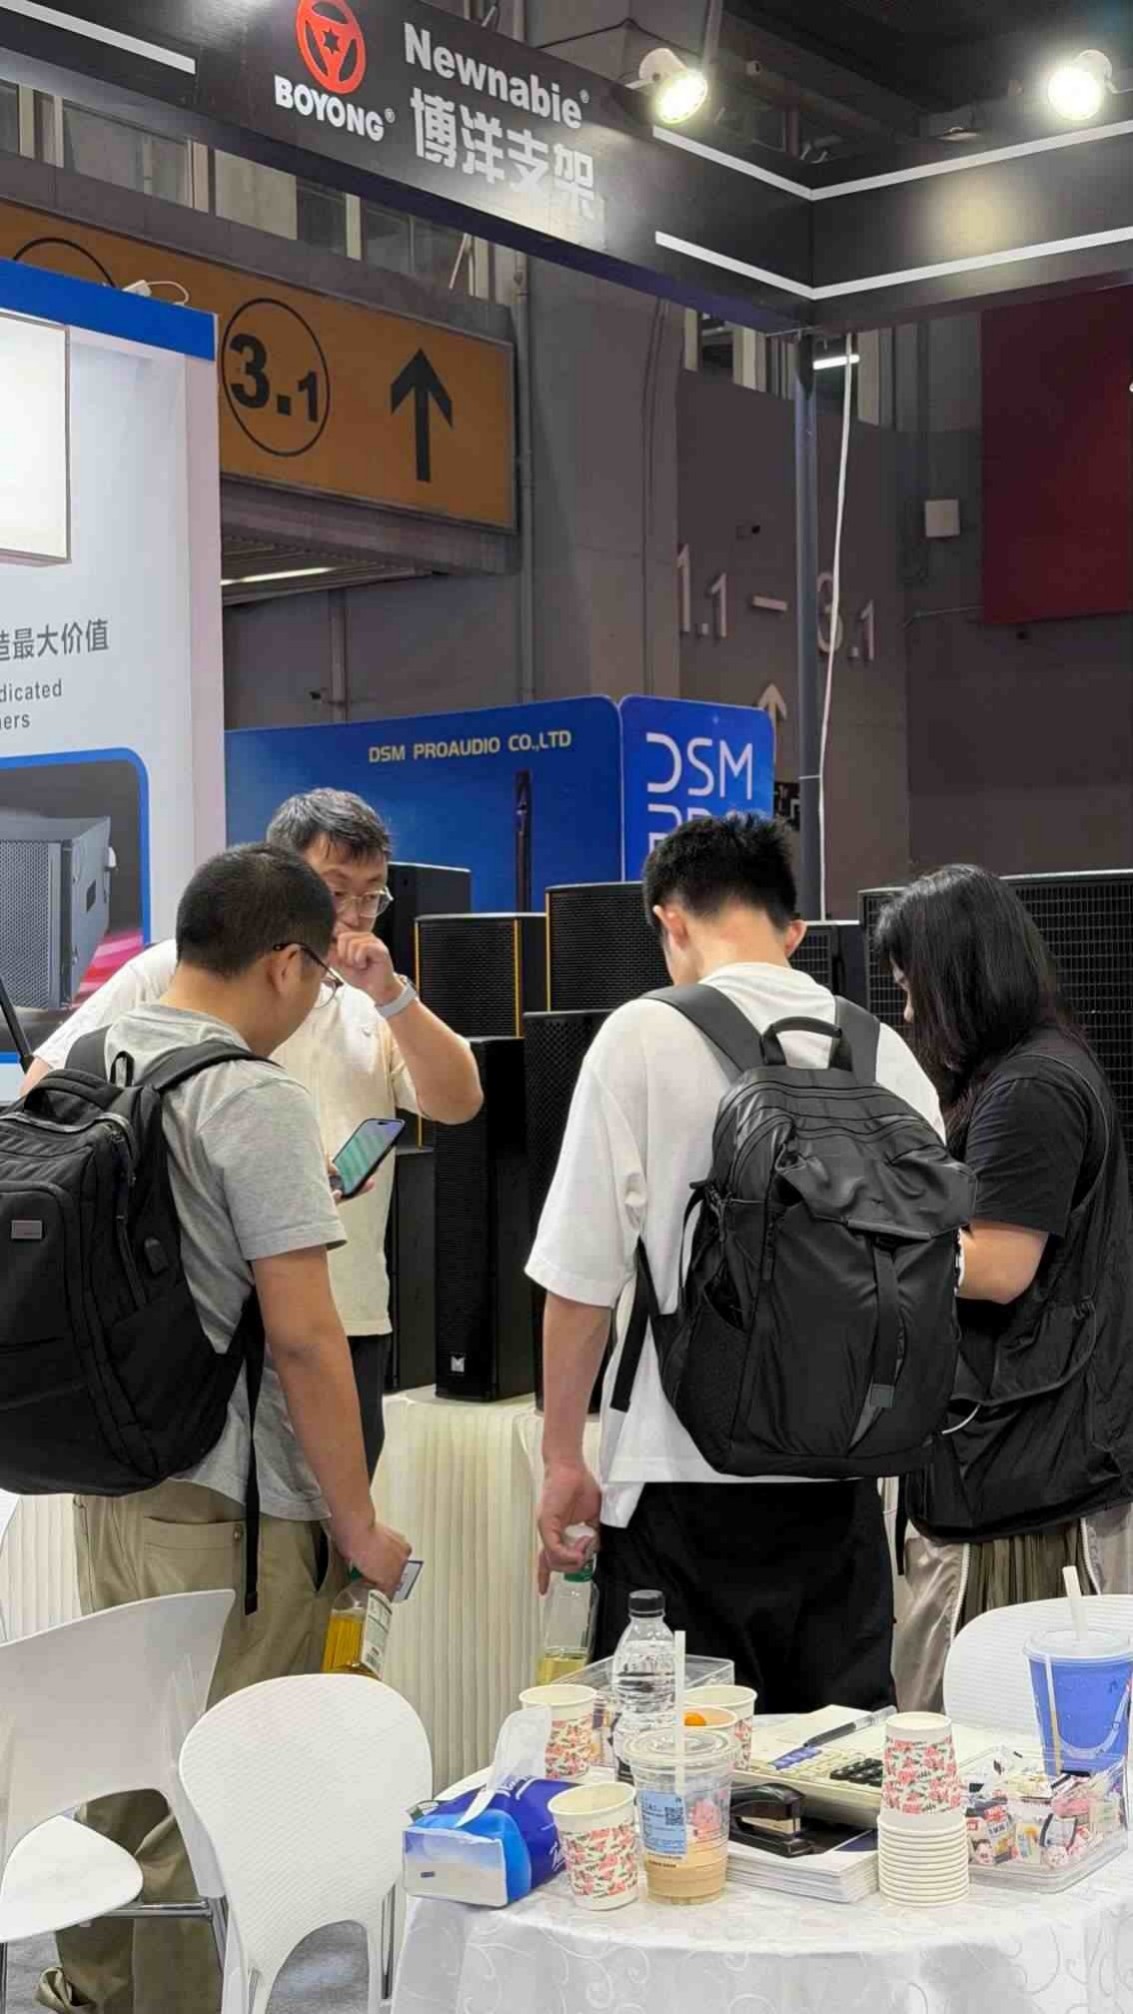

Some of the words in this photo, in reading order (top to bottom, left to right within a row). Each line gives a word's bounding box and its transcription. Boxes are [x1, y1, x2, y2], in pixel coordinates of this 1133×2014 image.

[410, 87, 595, 219] 博洋支架
[230, 334, 318, 423] 3.1
[368, 745, 406, 763] DSM
[413, 736, 501, 760] PROAUDIO
[646, 732, 753, 800] DSM
